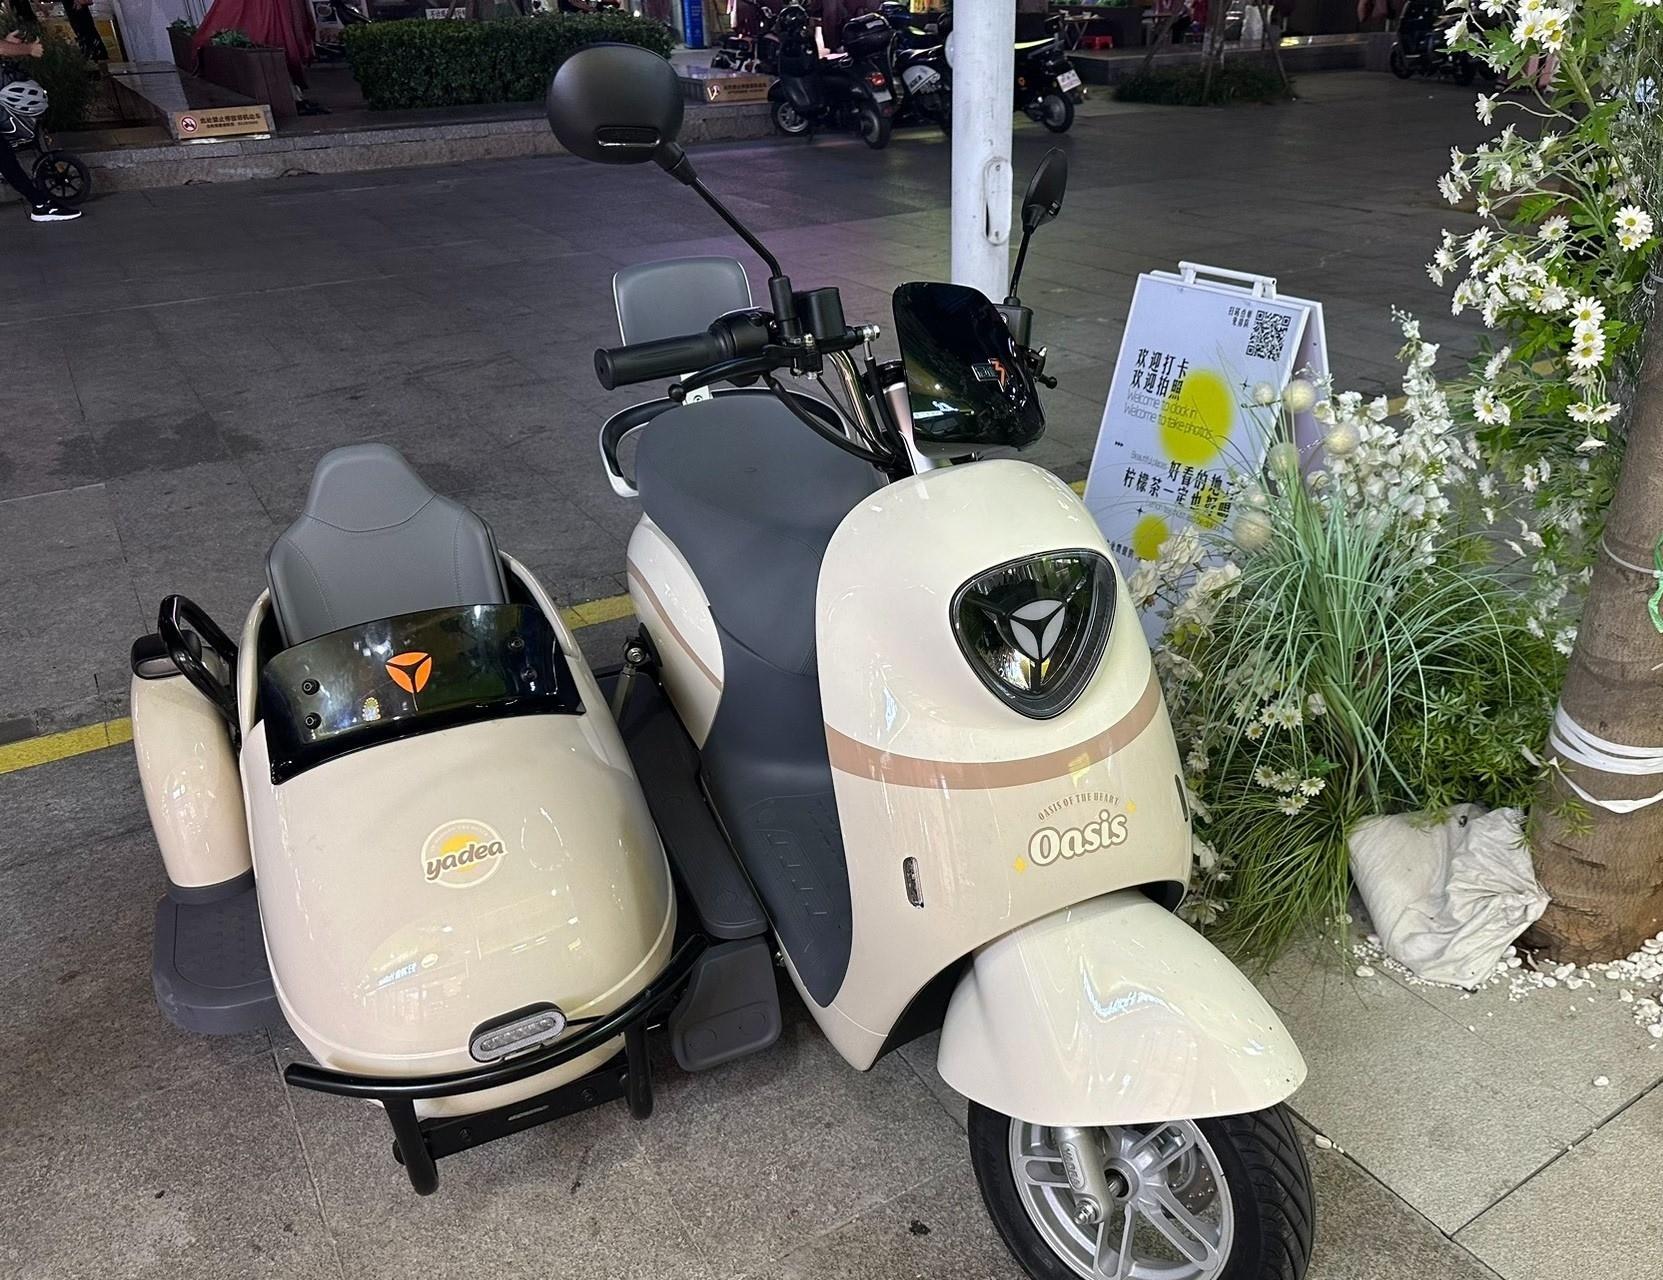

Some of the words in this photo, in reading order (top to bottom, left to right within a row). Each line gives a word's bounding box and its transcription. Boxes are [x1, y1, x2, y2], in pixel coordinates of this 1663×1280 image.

[1136, 348, 1189, 378] 欢迎打卡
[1131, 369, 1183, 400] 欢迎拍照
[1123, 402, 1157, 422] Welcome
[1157, 414, 1166, 426] to
[1127, 388, 1160, 409] Welcome
[1161, 400, 1169, 412] to
[1038, 800, 1062, 821] OASIS
[1063, 796, 1073, 807] OF
[1075, 793, 1092, 804] THE
[1094, 792, 1119, 806] HEART
[1028, 808, 1128, 867] Oasis
[425, 840, 505, 881] yadea
